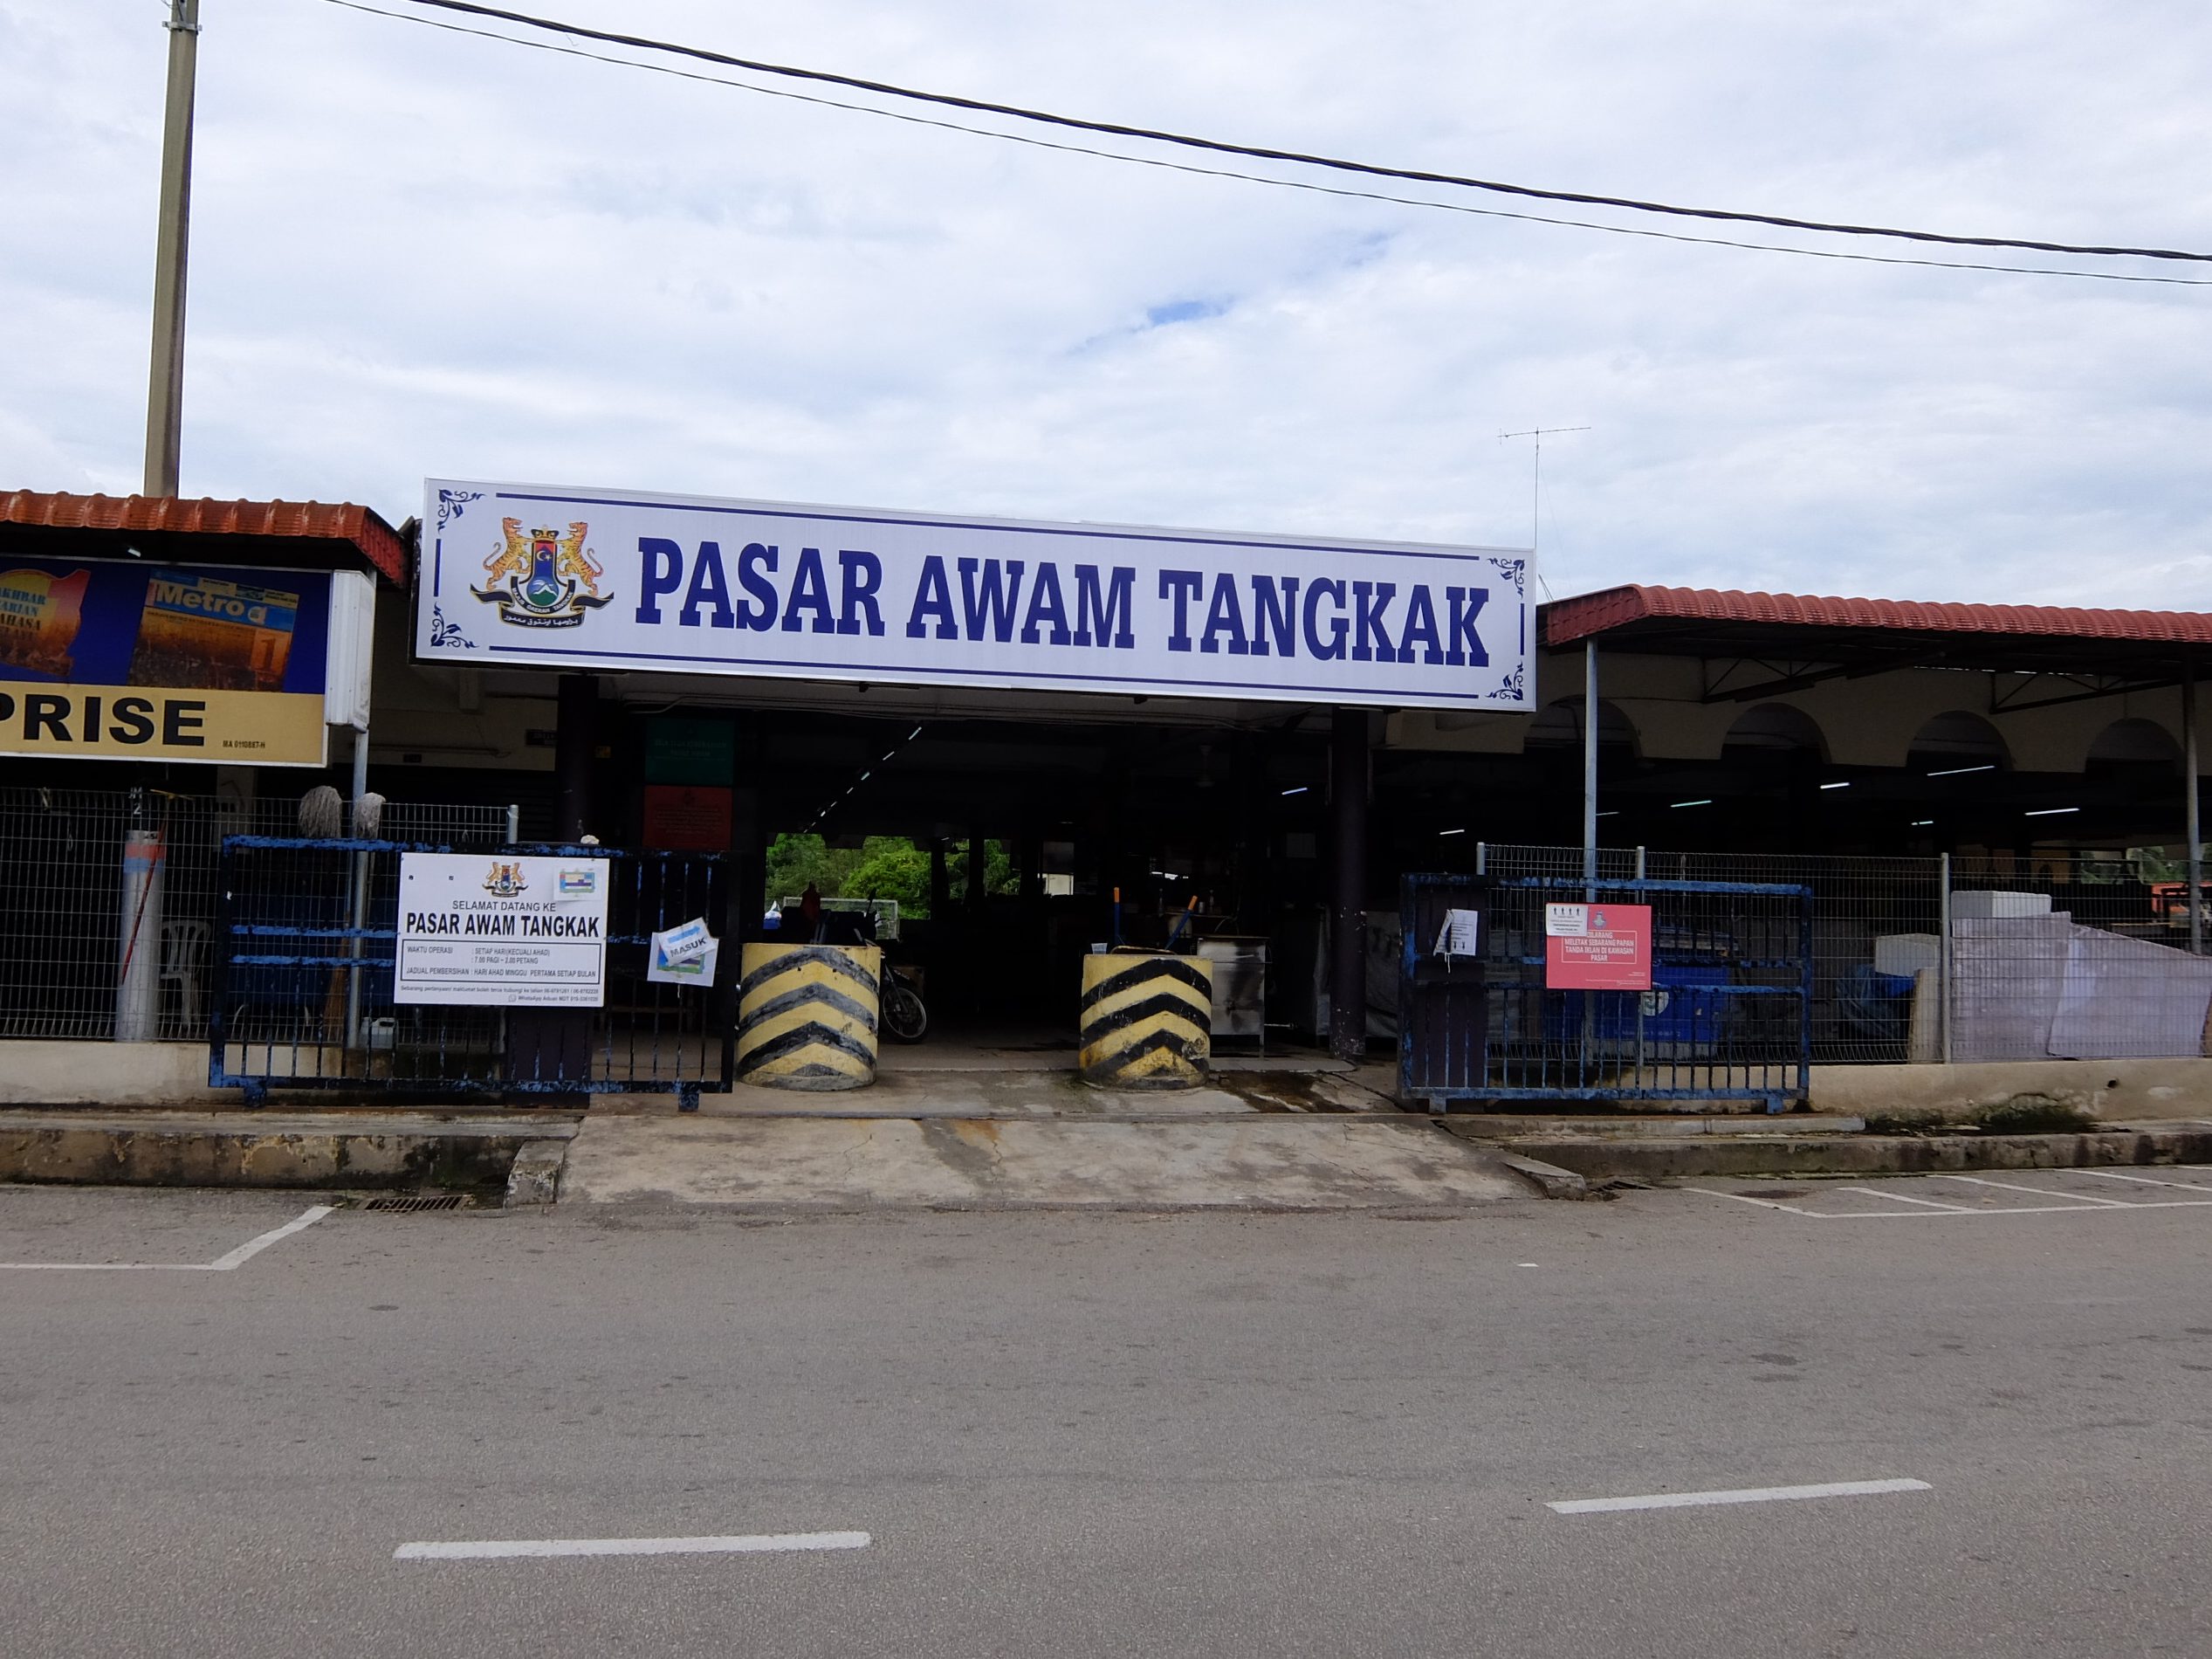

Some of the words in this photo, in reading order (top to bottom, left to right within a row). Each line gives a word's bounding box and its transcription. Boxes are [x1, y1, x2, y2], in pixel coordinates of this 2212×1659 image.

[156, 582, 245, 616] Metro
[635, 537, 884, 637] PASAR
[906, 555, 1136, 649] AWAM
[1158, 569, 1489, 667] TANGKAK
[453, 900, 498, 910] SELAMAT
[501, 902, 540, 911] DATANG
[543, 903, 556, 912] KE
[407, 912, 459, 934] PASAR
[465, 914, 515, 935] AWAM
[521, 916, 599, 937] TANGKAK
[670, 937, 706, 957] MASUK
